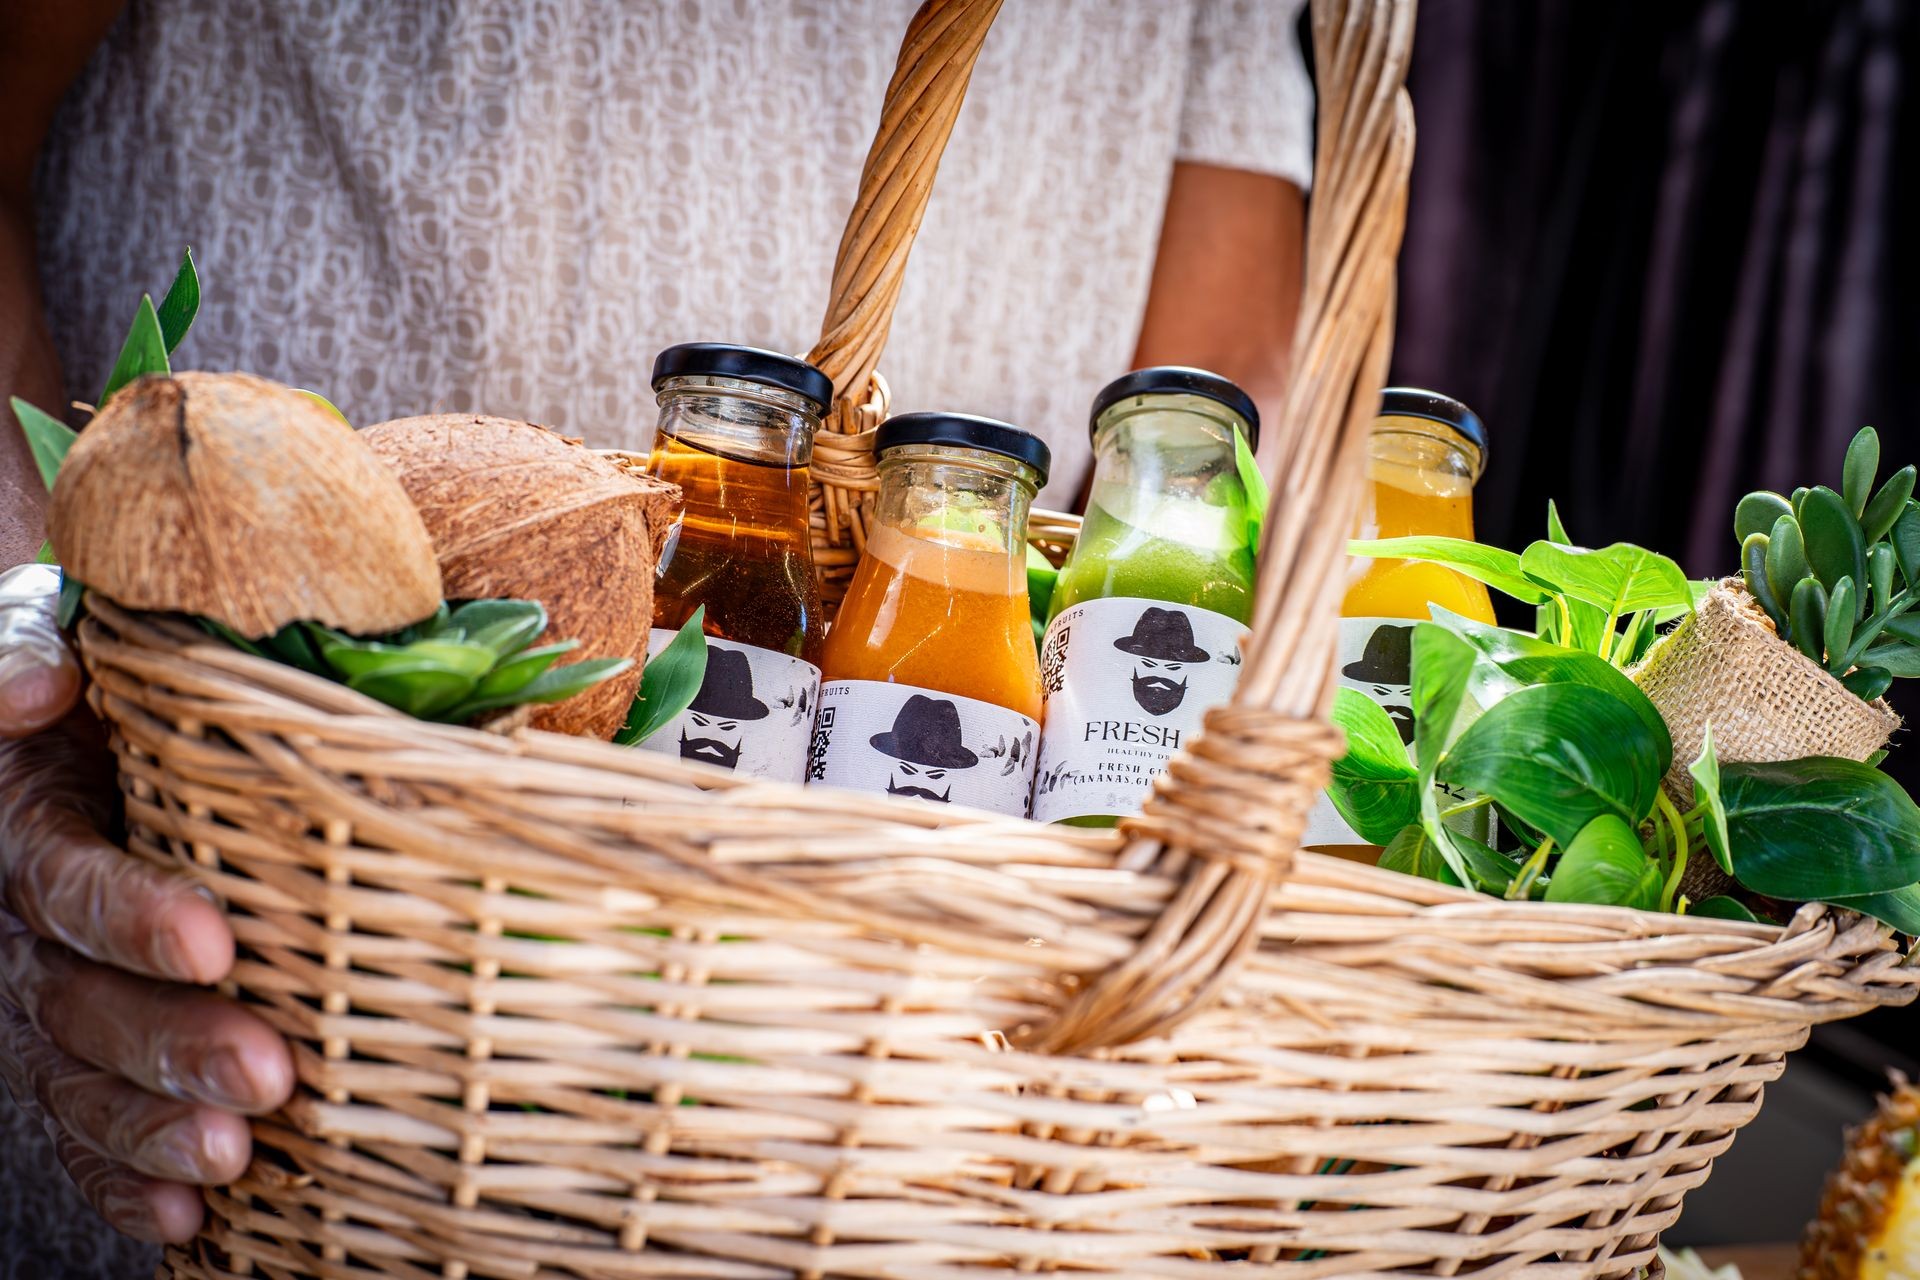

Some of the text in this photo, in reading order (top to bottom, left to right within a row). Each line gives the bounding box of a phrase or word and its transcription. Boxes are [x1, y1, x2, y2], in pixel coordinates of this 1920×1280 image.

[1084, 720, 1181, 749] FRESH
[1107, 748, 1170, 761] HEALTHY DR
[1098, 762, 1141, 774] FRESH
[1073, 774, 1149, 786] (ANANAS.GI
